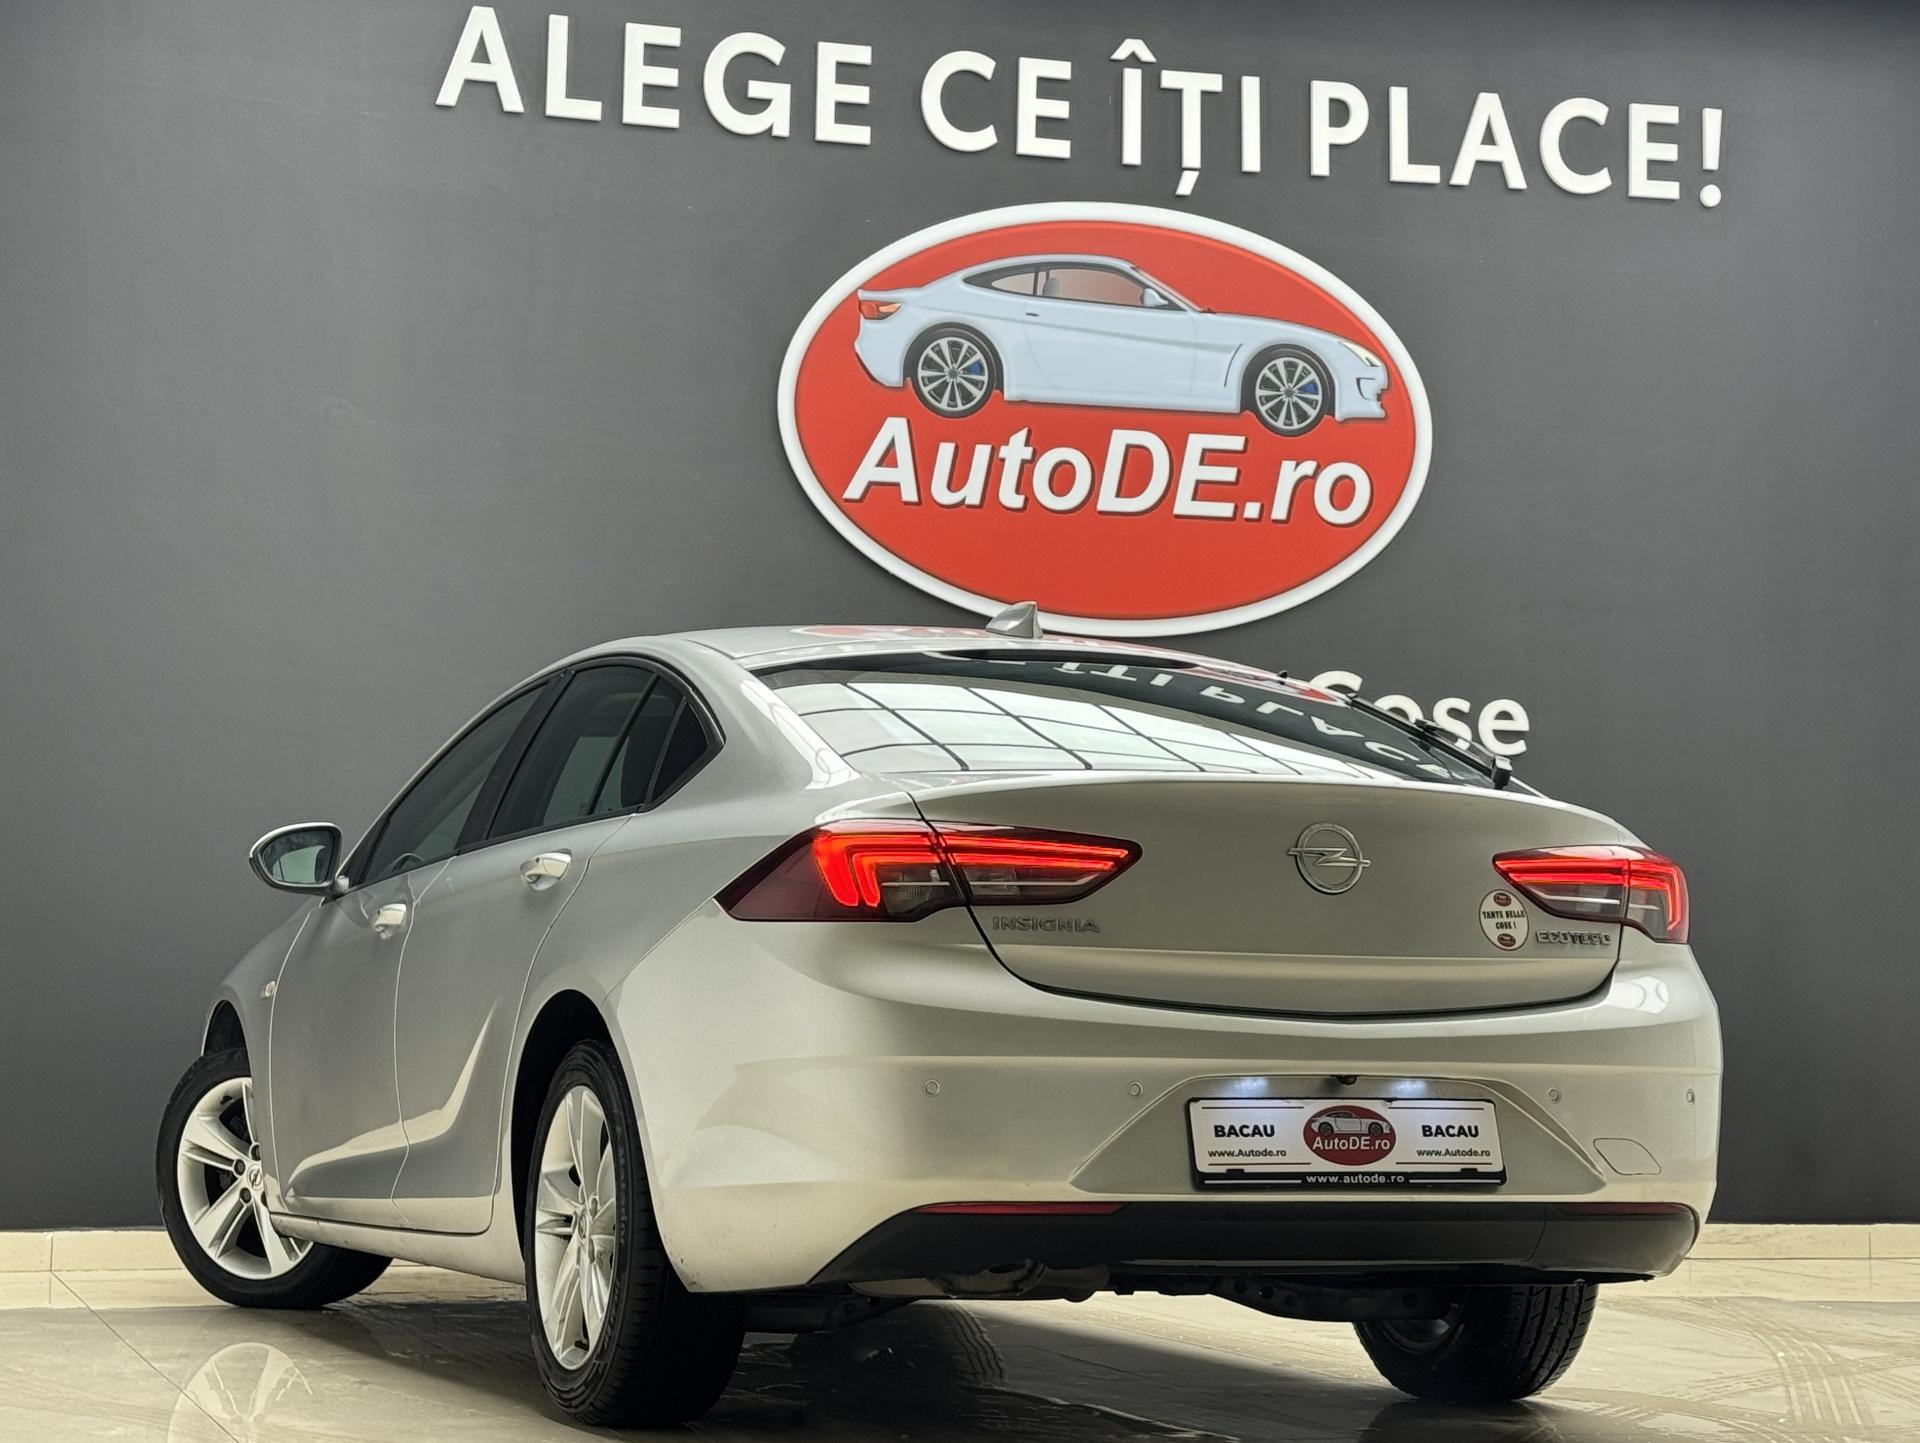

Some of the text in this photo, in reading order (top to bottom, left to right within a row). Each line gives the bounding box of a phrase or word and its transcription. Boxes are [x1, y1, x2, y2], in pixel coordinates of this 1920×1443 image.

[435, 5, 1723, 208] ALEGE CE ÎȚI PLACE!
[842, 416, 1372, 526] AutoDE.ro
[992, 916, 1100, 933] INSIGNIA
[1213, 1124, 1276, 1138] BACAU
[1421, 1124, 1480, 1138] BACAU
[1312, 1136, 1391, 1150] AutoDE.ro
[1208, 1147, 1287, 1158] www.Autode.ro
[1416, 1147, 1491, 1157] www.Autode.ro
[1306, 1173, 1405, 1184] www.autode.ro
